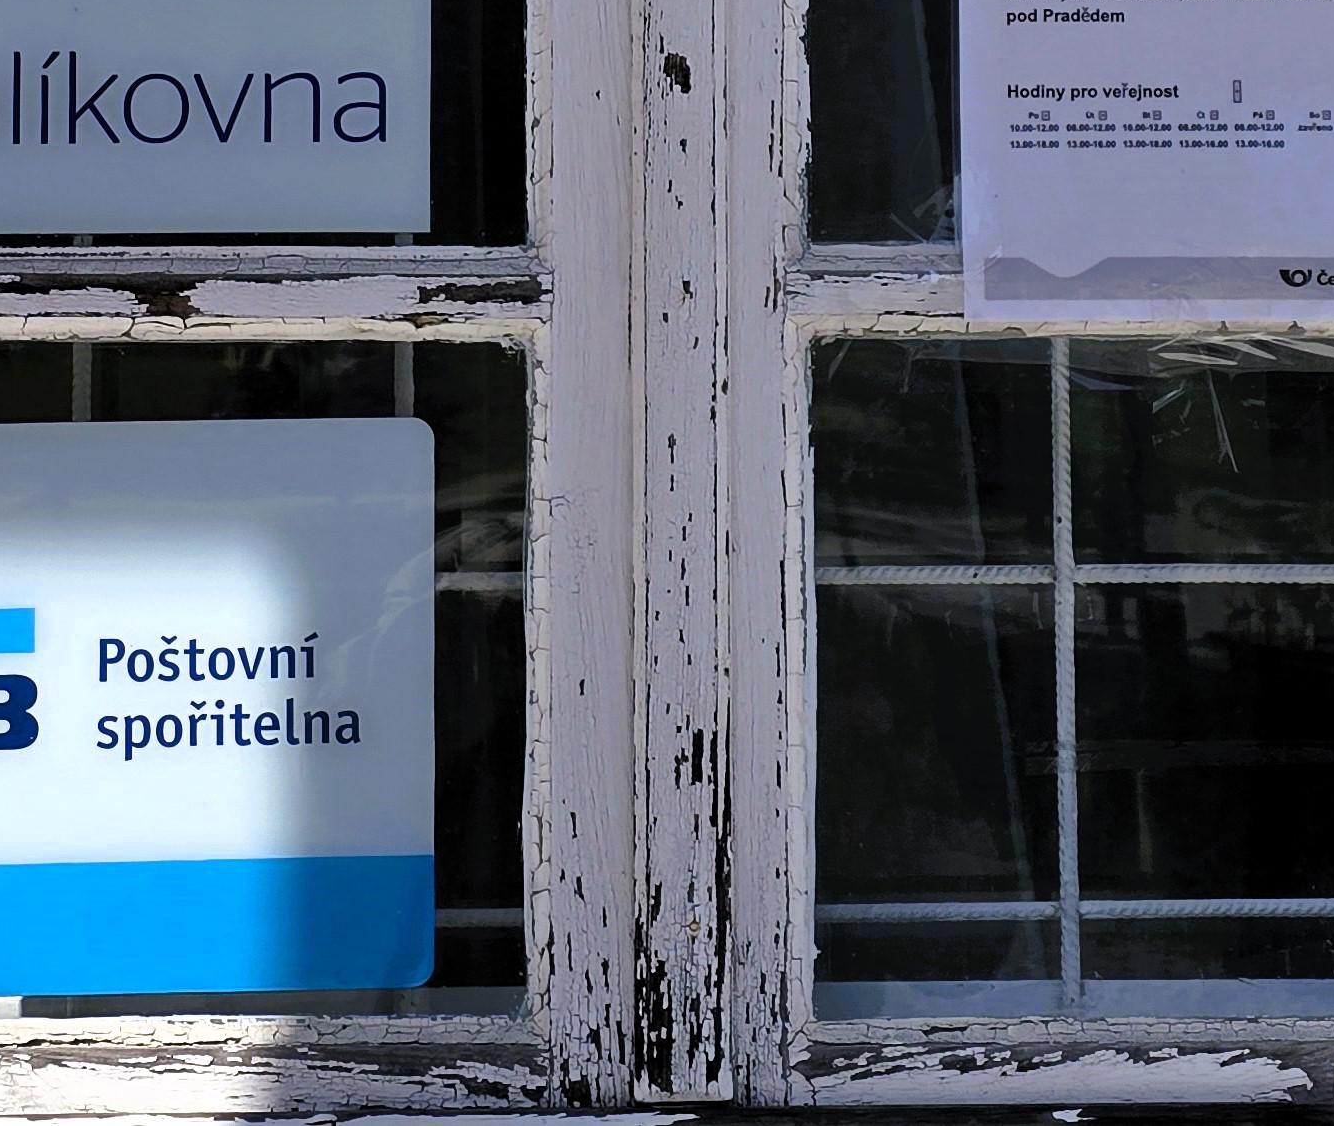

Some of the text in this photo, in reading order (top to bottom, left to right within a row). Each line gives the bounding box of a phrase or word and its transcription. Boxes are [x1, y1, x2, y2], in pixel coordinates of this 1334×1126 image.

[1006, 6, 1125, 26] pod Pradědem
[1007, 82, 1180, 102] Hodiny pro veřejnost
[98, 631, 320, 683] Poštovní
[96, 697, 361, 762] spořitelna
